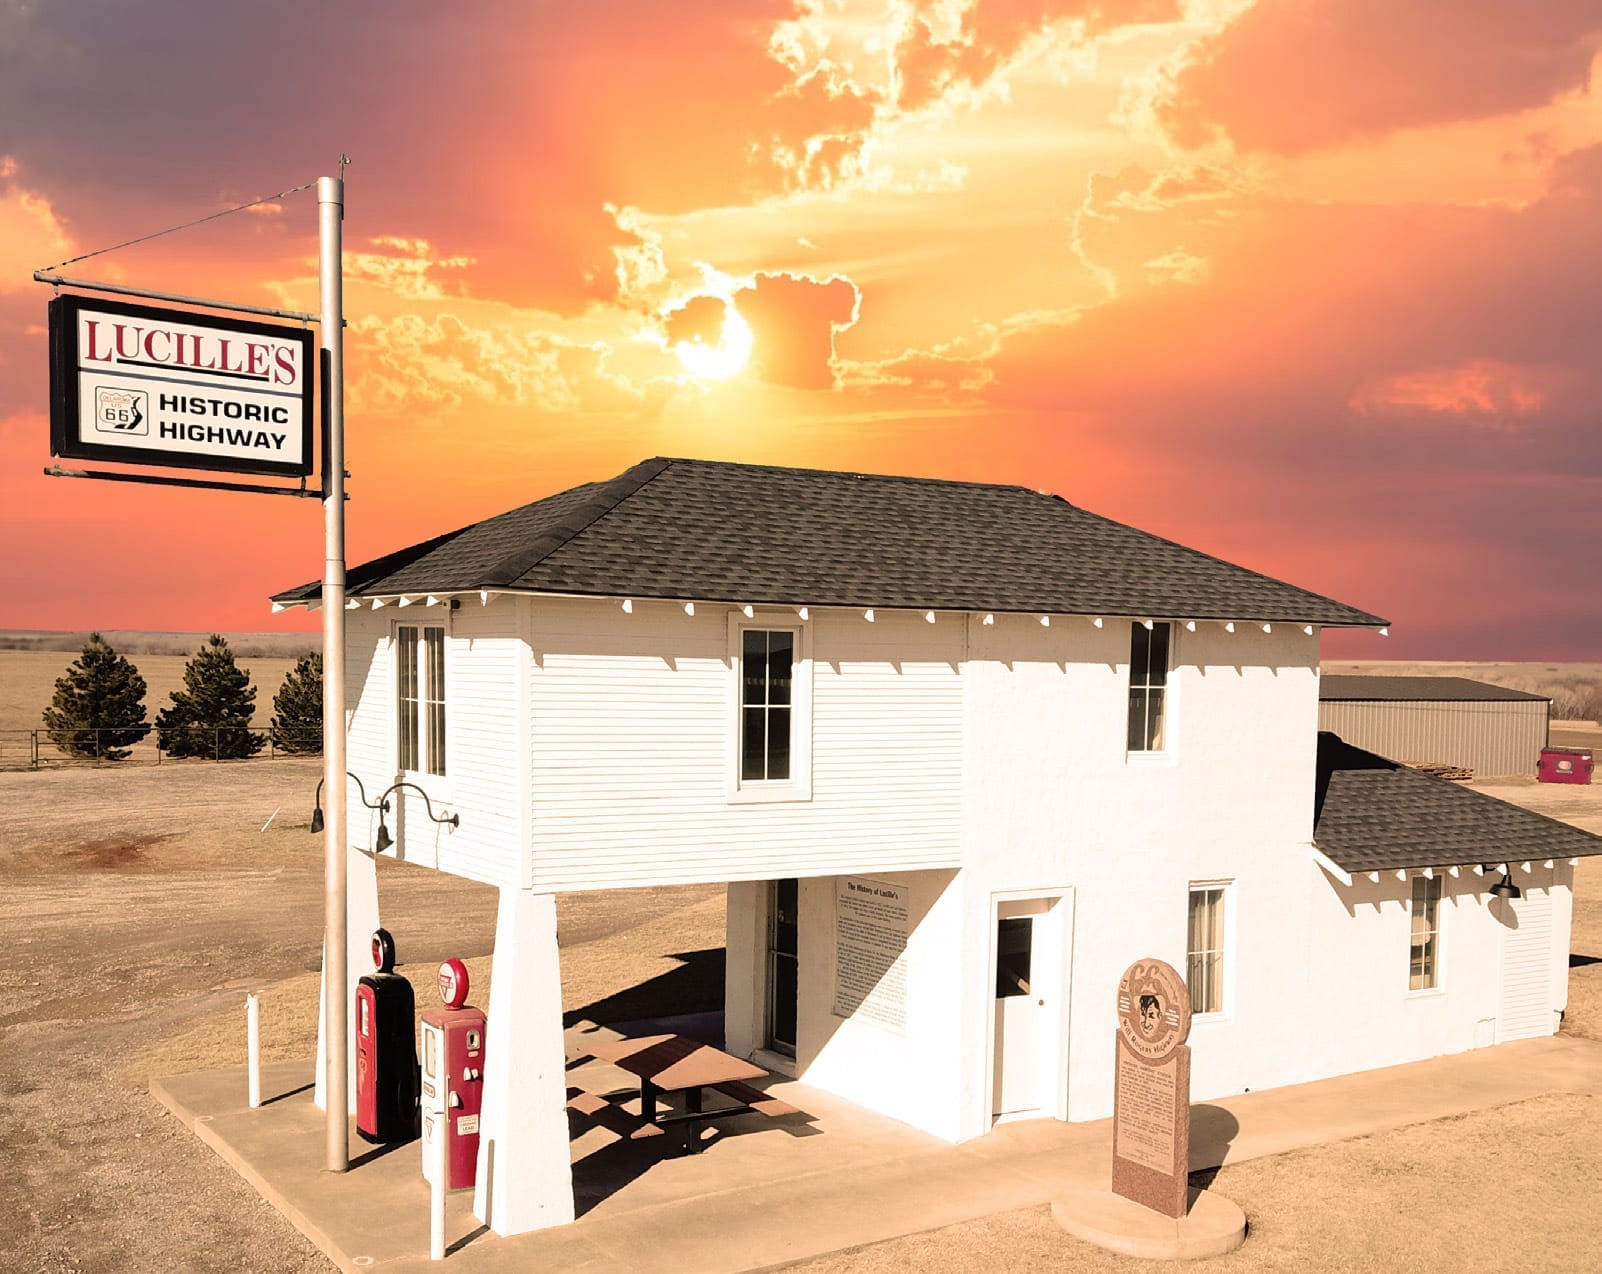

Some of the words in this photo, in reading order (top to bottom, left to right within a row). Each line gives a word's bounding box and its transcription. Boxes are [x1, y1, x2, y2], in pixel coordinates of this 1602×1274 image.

[84, 320, 296, 386] LUCILLE'S
[105, 408, 129, 422] 66
[159, 393, 289, 424] HISTORIC
[159, 421, 286, 450] HIGHWAY
[847, 881, 856, 891] The
[856, 884, 873, 896] History
